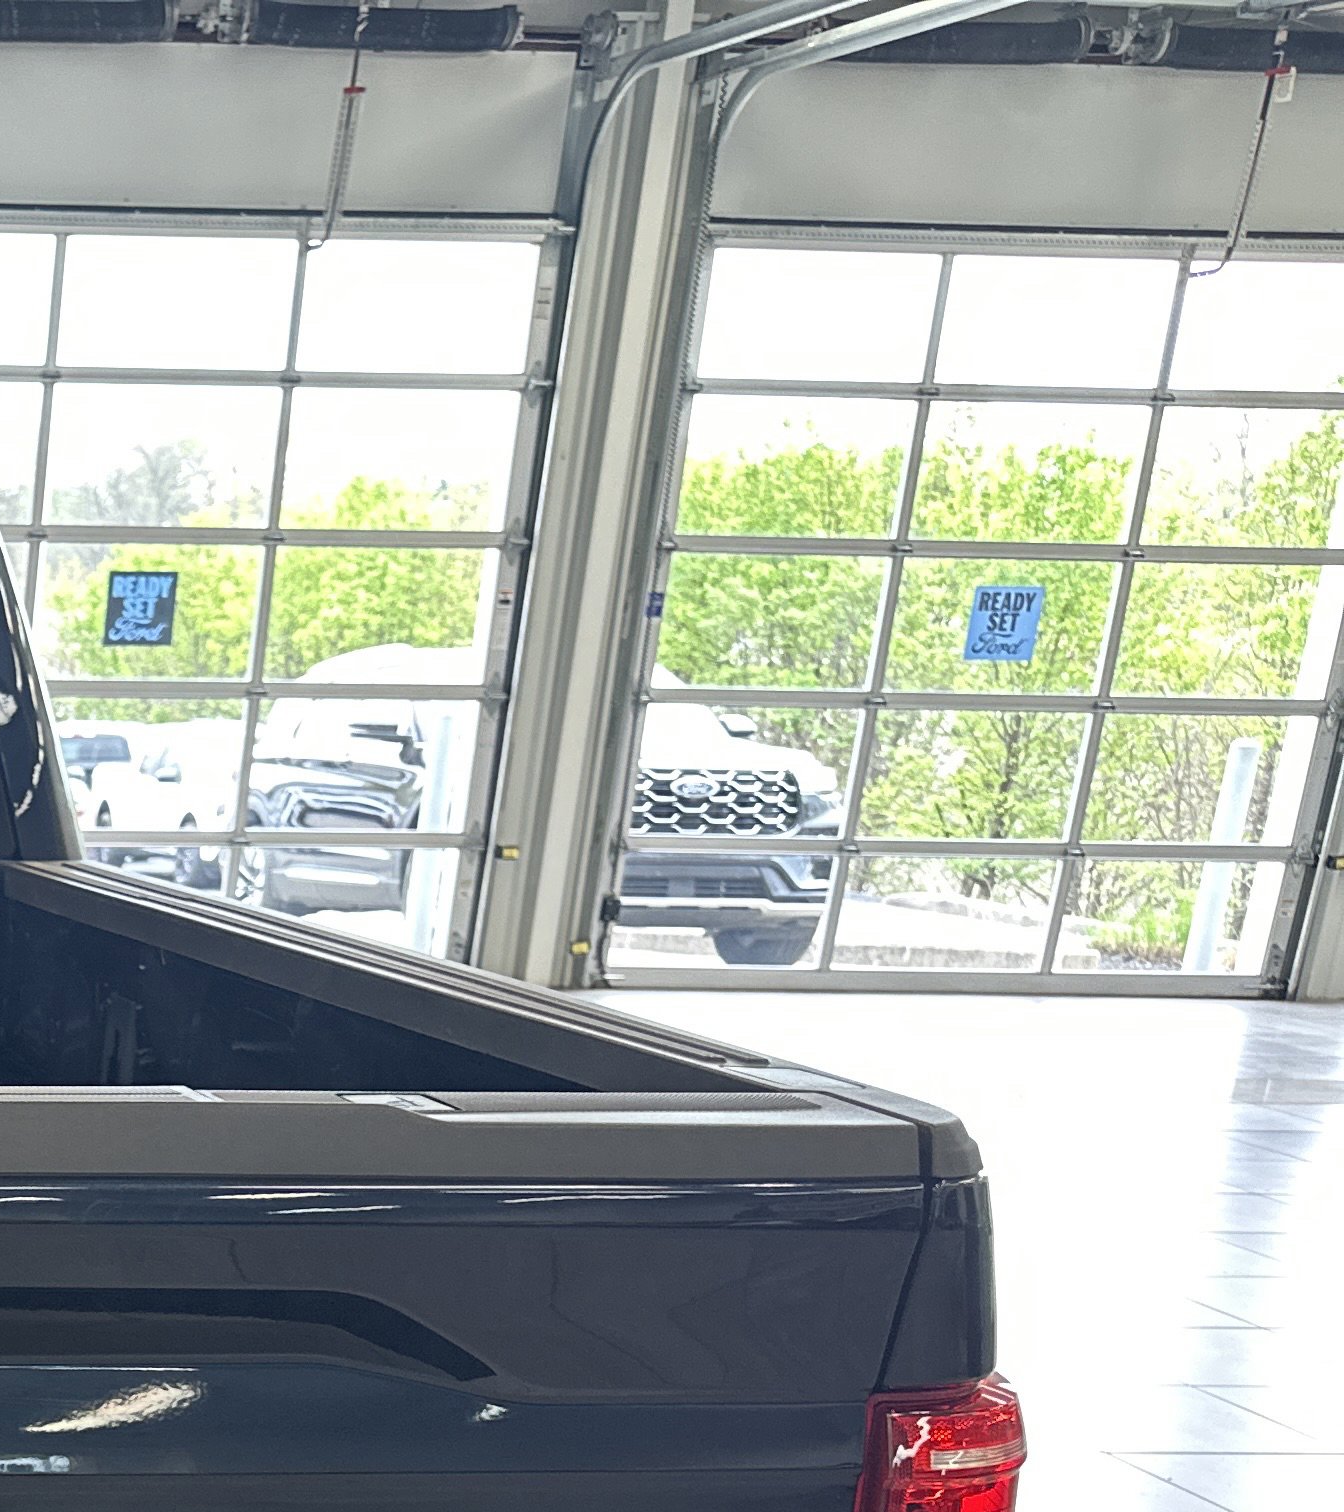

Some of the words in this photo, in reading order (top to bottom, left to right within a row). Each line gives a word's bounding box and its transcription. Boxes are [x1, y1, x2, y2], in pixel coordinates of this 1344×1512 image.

[112, 576, 174, 598] READY
[122, 598, 158, 619] SET
[978, 592, 1037, 612] READY
[108, 617, 168, 641] Ford
[987, 612, 1020, 632] SET
[971, 631, 1029, 655] Ford
